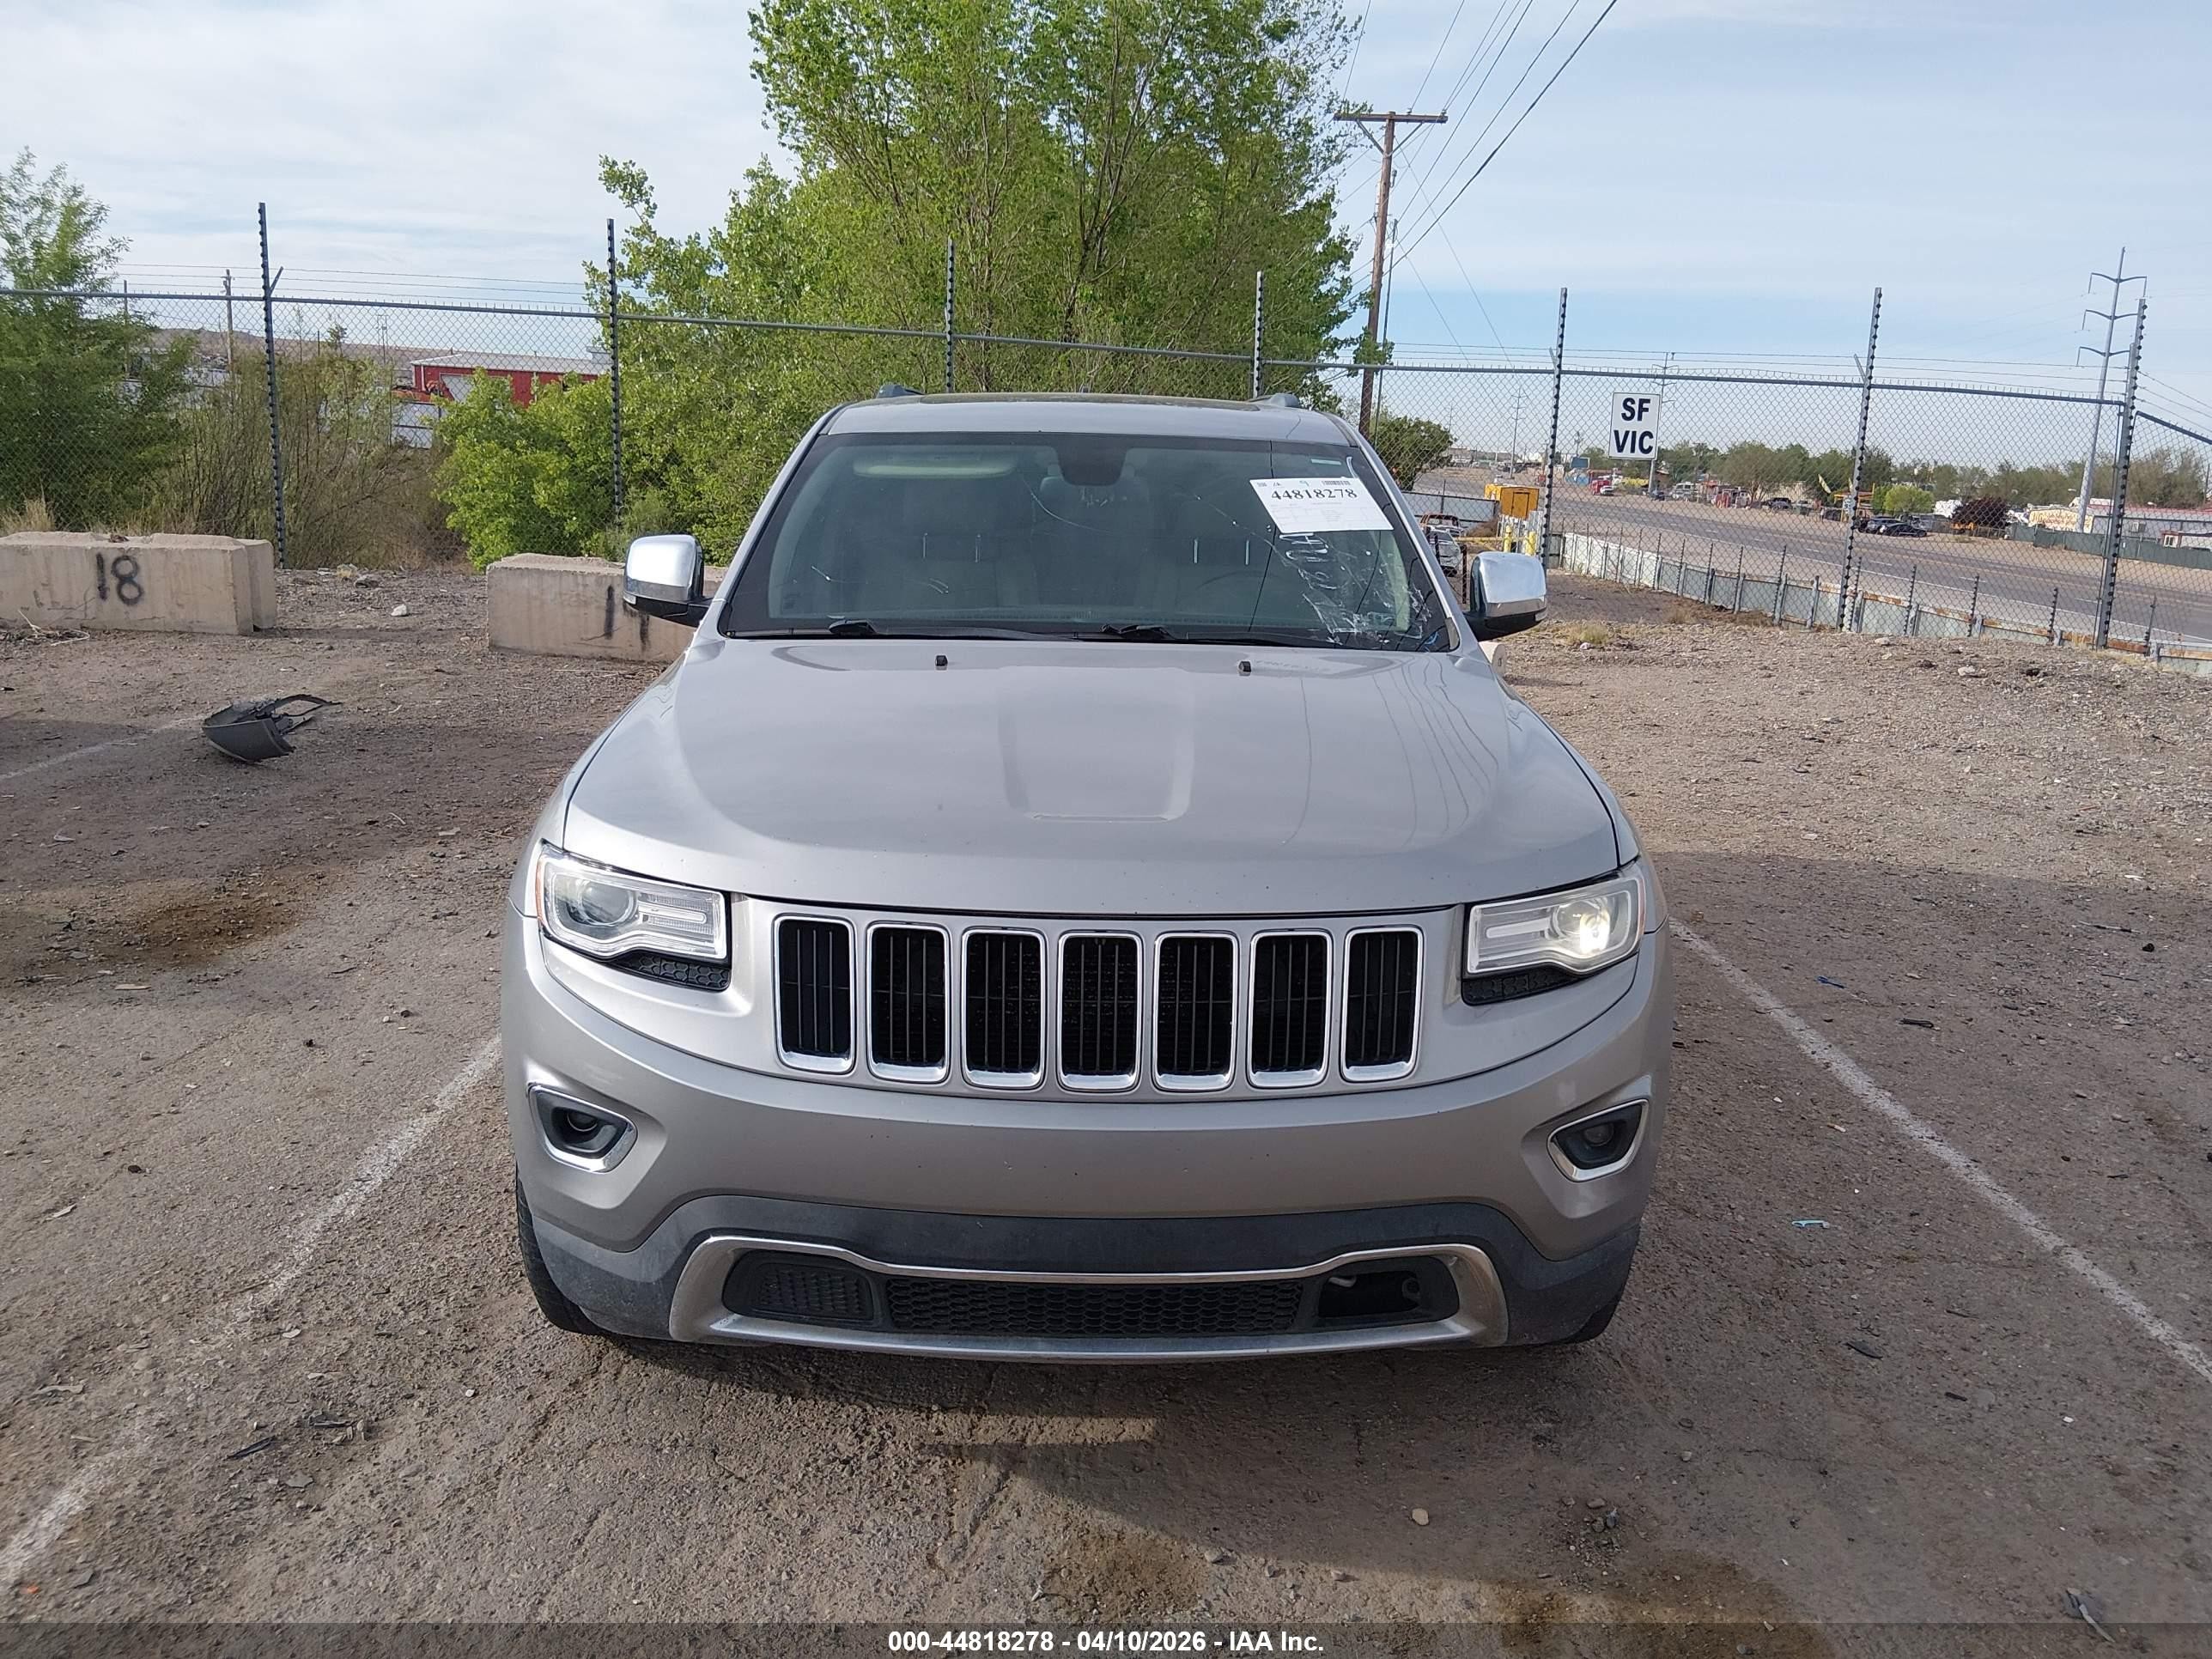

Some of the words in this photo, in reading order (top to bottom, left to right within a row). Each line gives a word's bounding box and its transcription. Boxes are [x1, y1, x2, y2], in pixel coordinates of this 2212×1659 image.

[1621, 398, 1650, 421] SF
[1613, 429, 1654, 454] VIC
[1271, 488, 1358, 500] 44818278
[96, 552, 144, 605] 18
